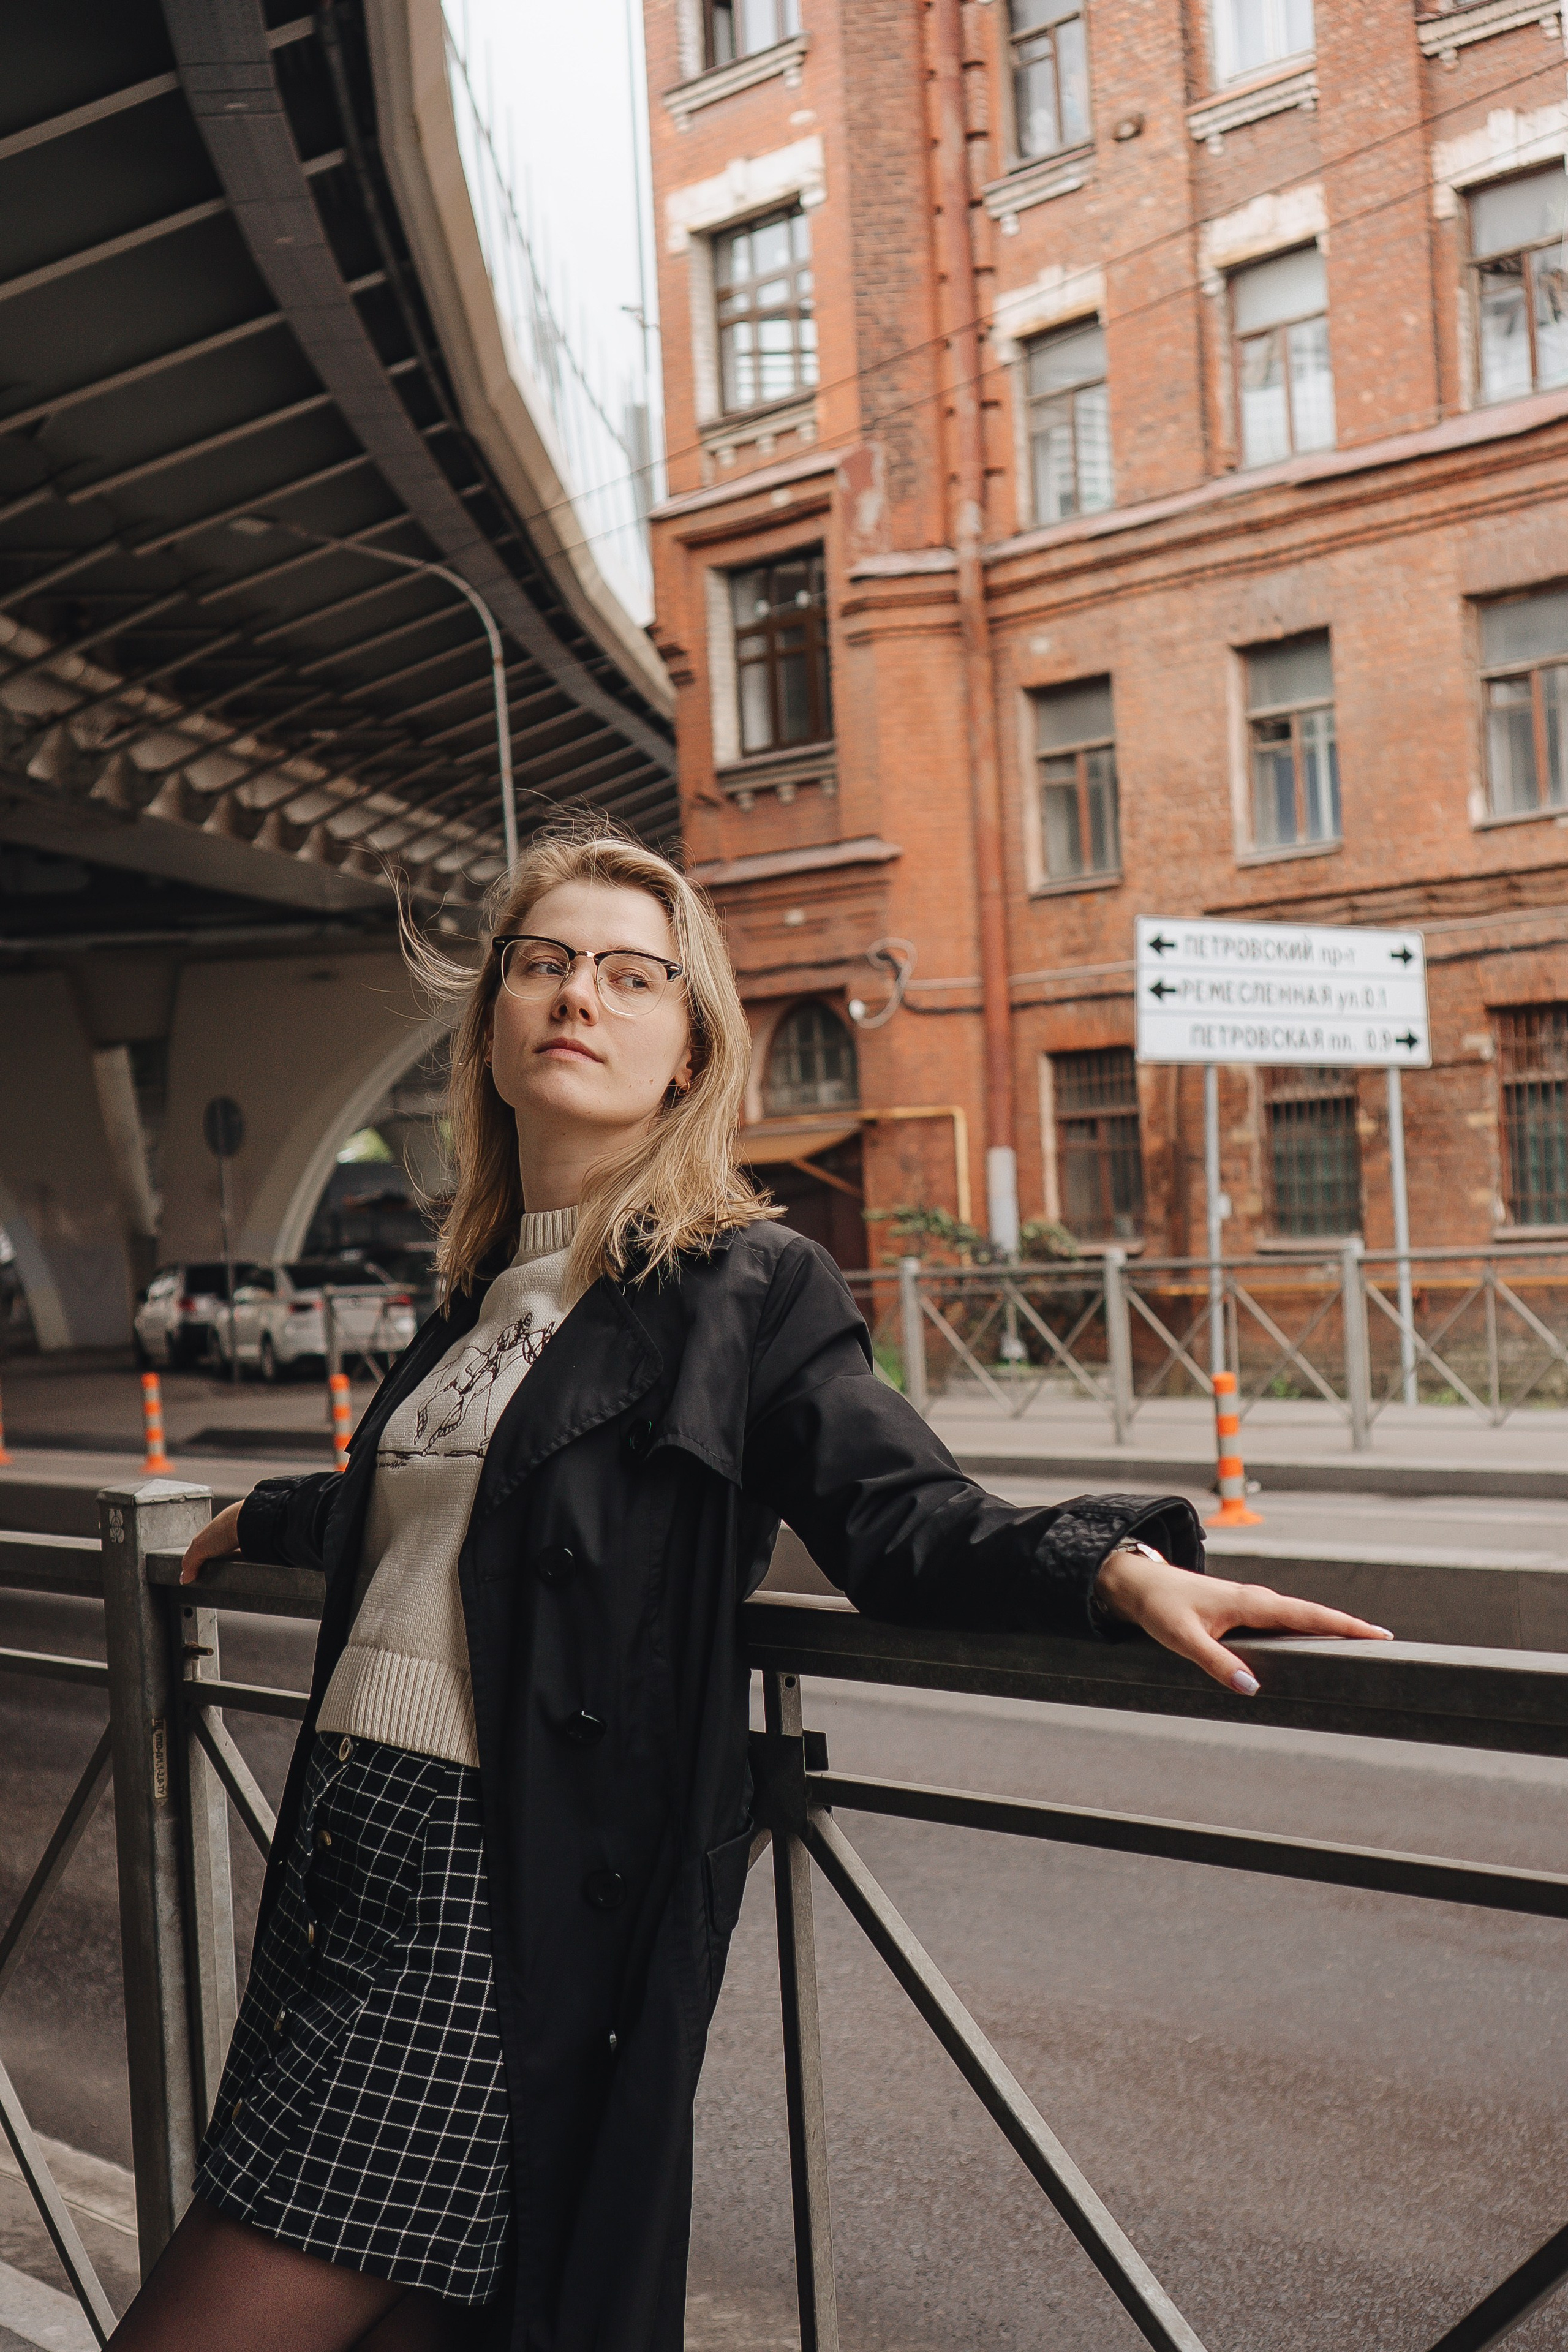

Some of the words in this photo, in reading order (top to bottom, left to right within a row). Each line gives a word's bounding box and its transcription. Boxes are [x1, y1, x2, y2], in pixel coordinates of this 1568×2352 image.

[1184, 934, 1314, 962] ПЕТРОВСКИЙ
[1182, 979, 1333, 1006] РЕМЕСЛЕННАЯ
[1191, 1024, 1324, 1050] ПЕТРОВСКАЯ
